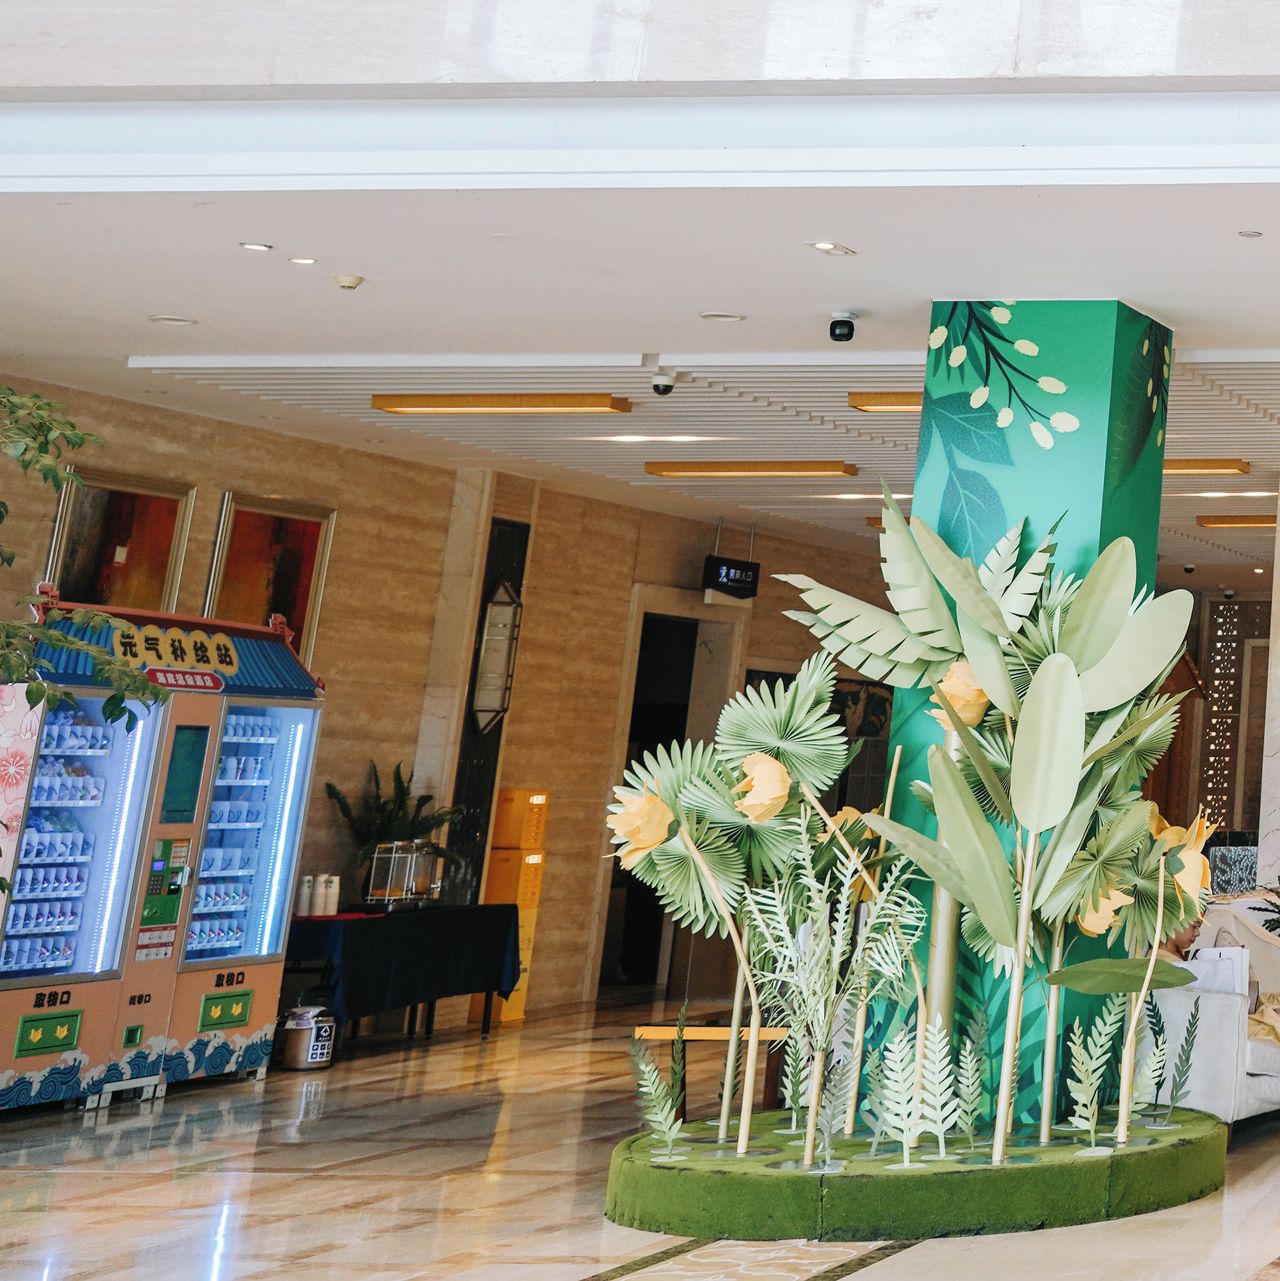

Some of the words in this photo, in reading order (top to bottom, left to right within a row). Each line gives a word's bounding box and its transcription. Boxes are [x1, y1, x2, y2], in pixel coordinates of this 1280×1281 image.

[120, 633, 234, 666] 元气补给站
[214, 972, 245, 987] 取物口
[33, 991, 71, 1008] 取物口
